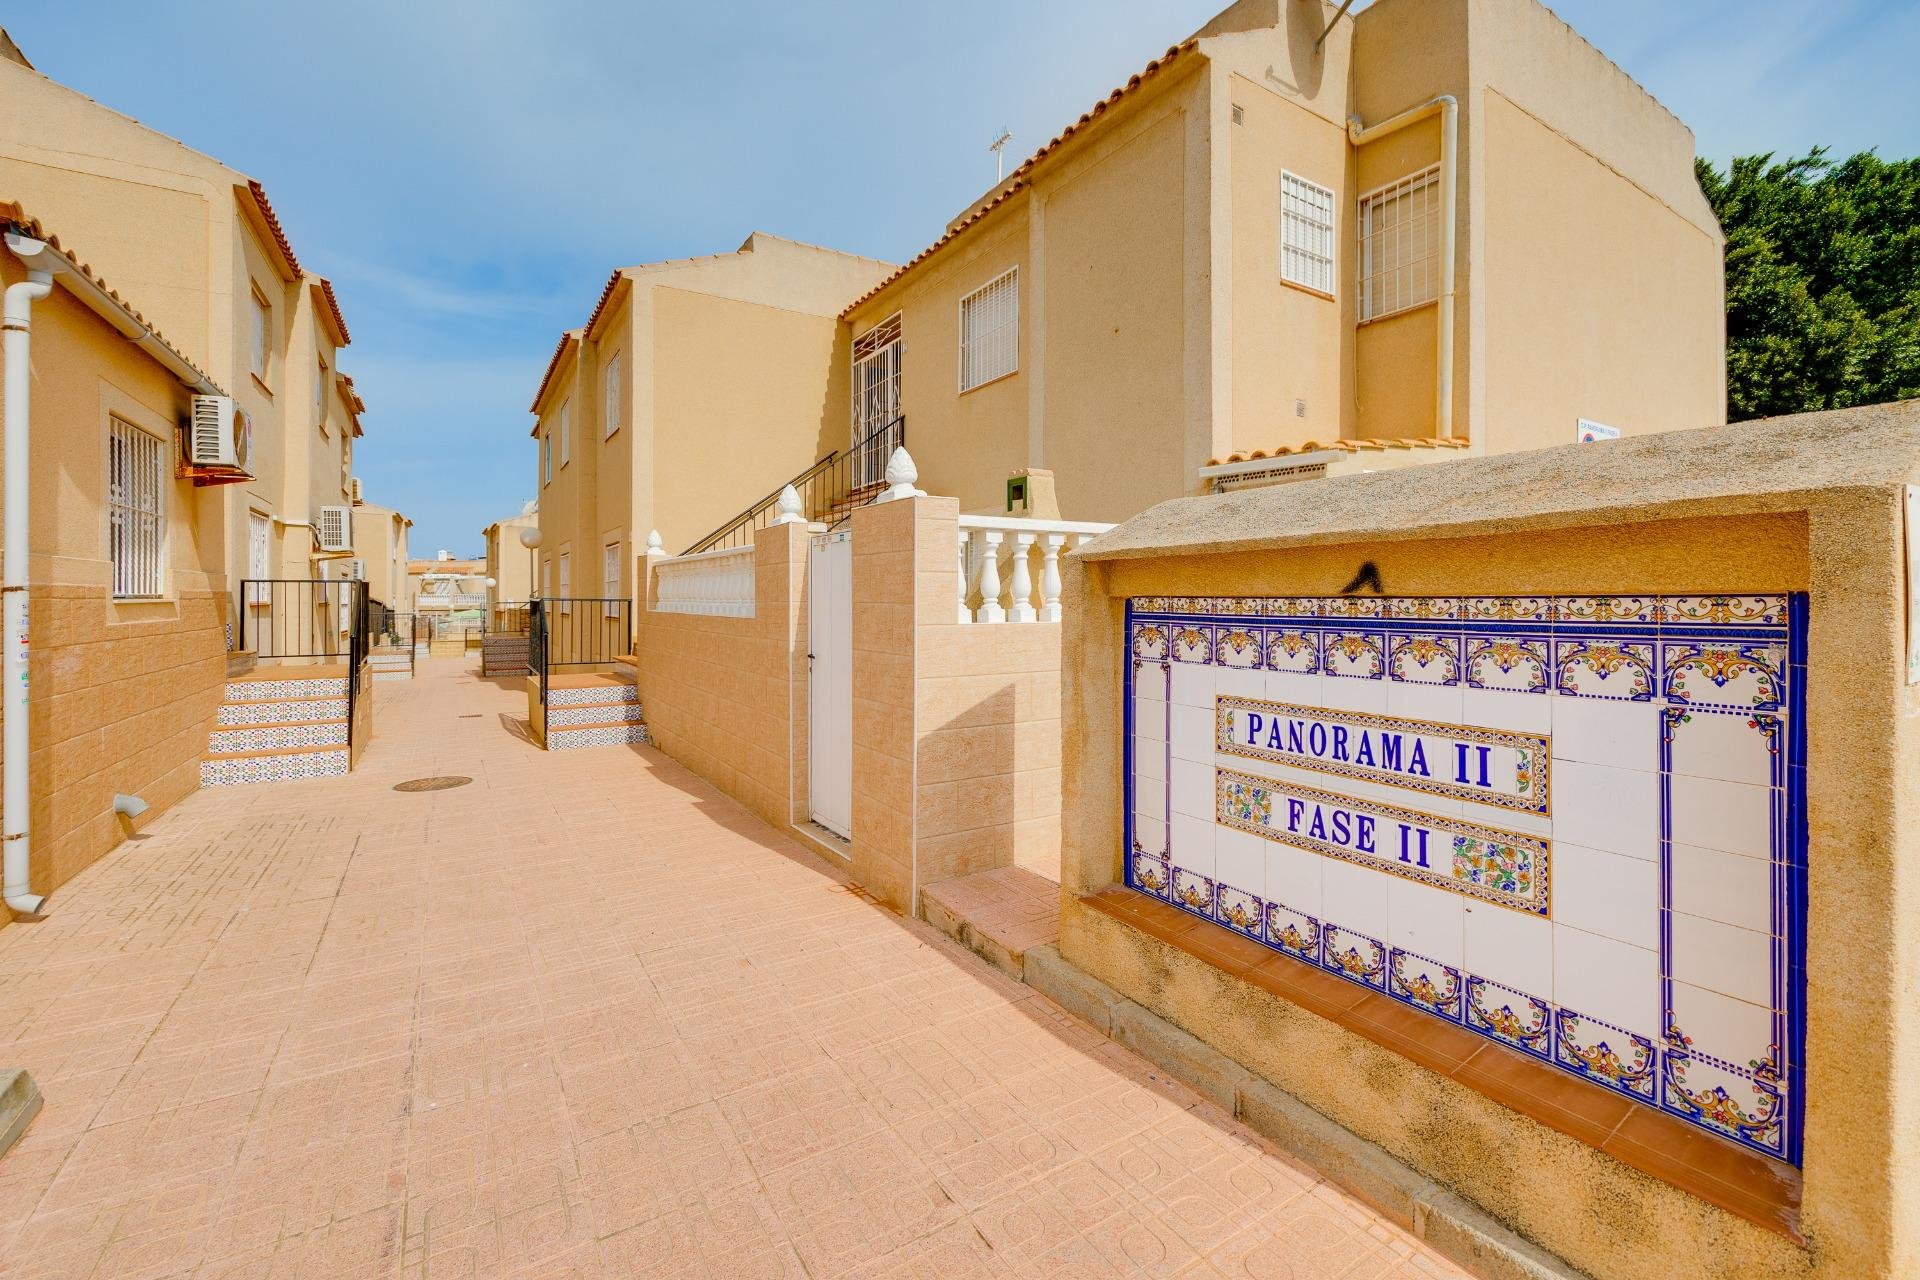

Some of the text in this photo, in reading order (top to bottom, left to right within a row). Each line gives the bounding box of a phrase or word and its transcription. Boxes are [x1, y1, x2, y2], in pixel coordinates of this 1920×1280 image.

[1247, 712, 1492, 788] PANORAMA II
[1287, 798, 1431, 869] FASE II
